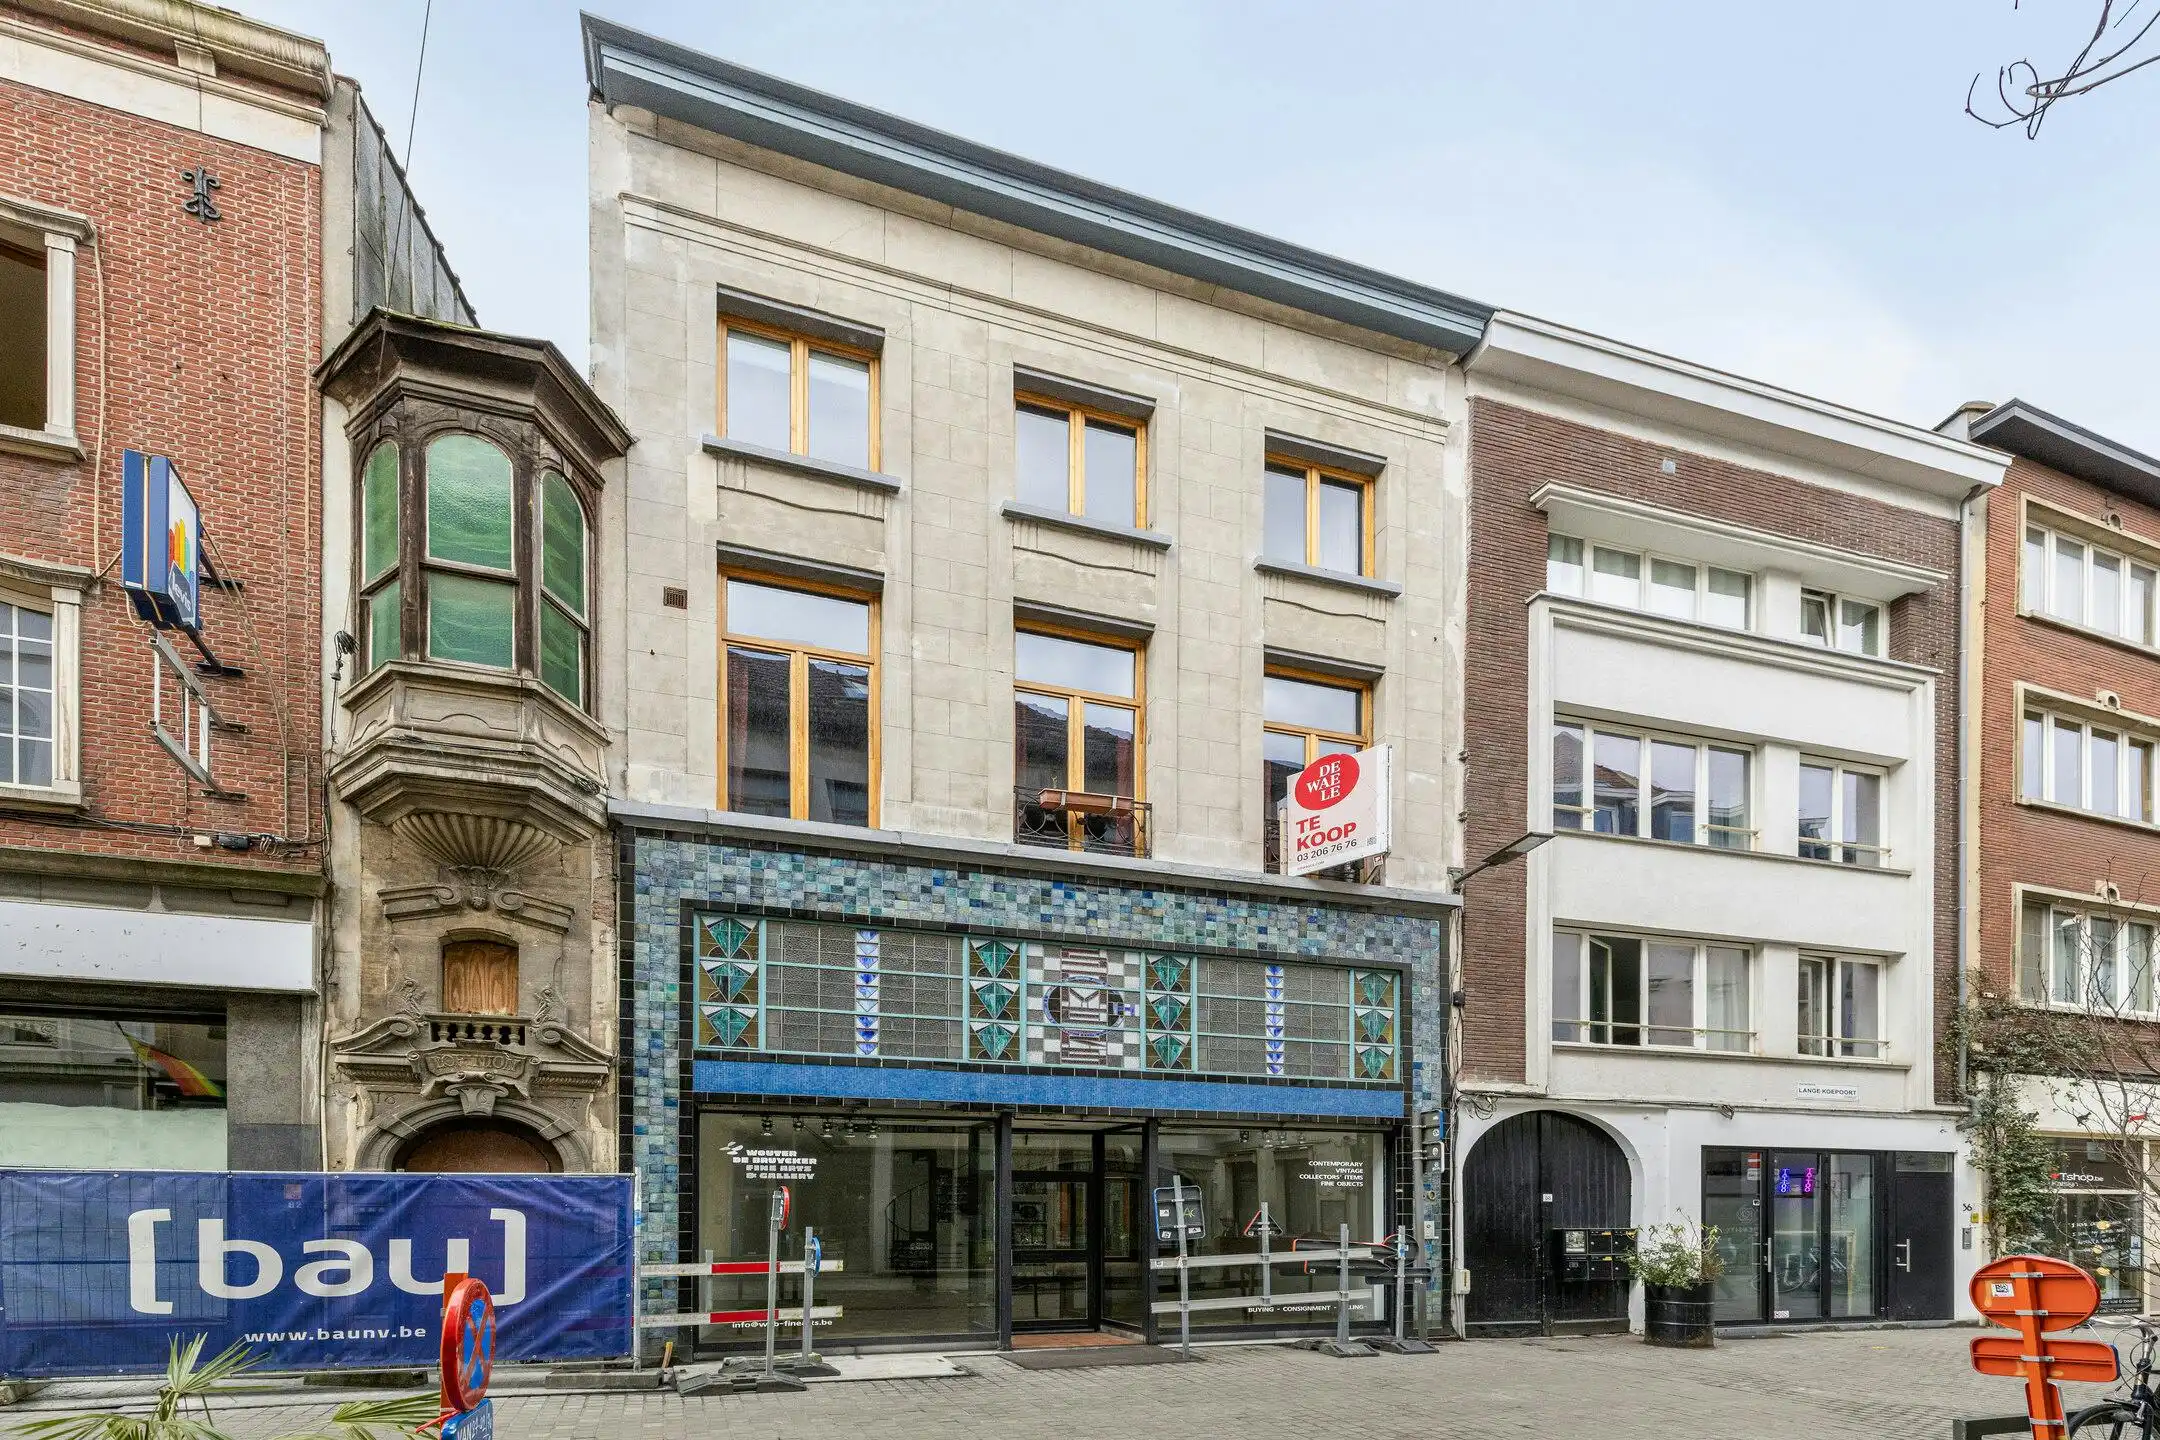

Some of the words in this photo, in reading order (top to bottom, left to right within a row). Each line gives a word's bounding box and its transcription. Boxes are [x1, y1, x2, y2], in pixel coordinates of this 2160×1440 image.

[1320, 760, 1340, 777] DE
[1306, 773, 1340, 793] WAE
[1321, 785, 1340, 801] LE
[1296, 815, 1320, 834] TE
[1297, 822, 1357, 851] KOOP
[1297, 853, 1309, 862] 03
[1311, 847, 1329, 859] 206
[1331, 843, 1343, 852] 76
[1345, 838, 1357, 849] 76
[1822, 1088, 1857, 1096] KOEPOORT
[746, 1149, 797, 1157] WOUTER
[752, 1157, 817, 1165] BRUYCKER
[245, 1326, 427, 1342] www.baunv.be
